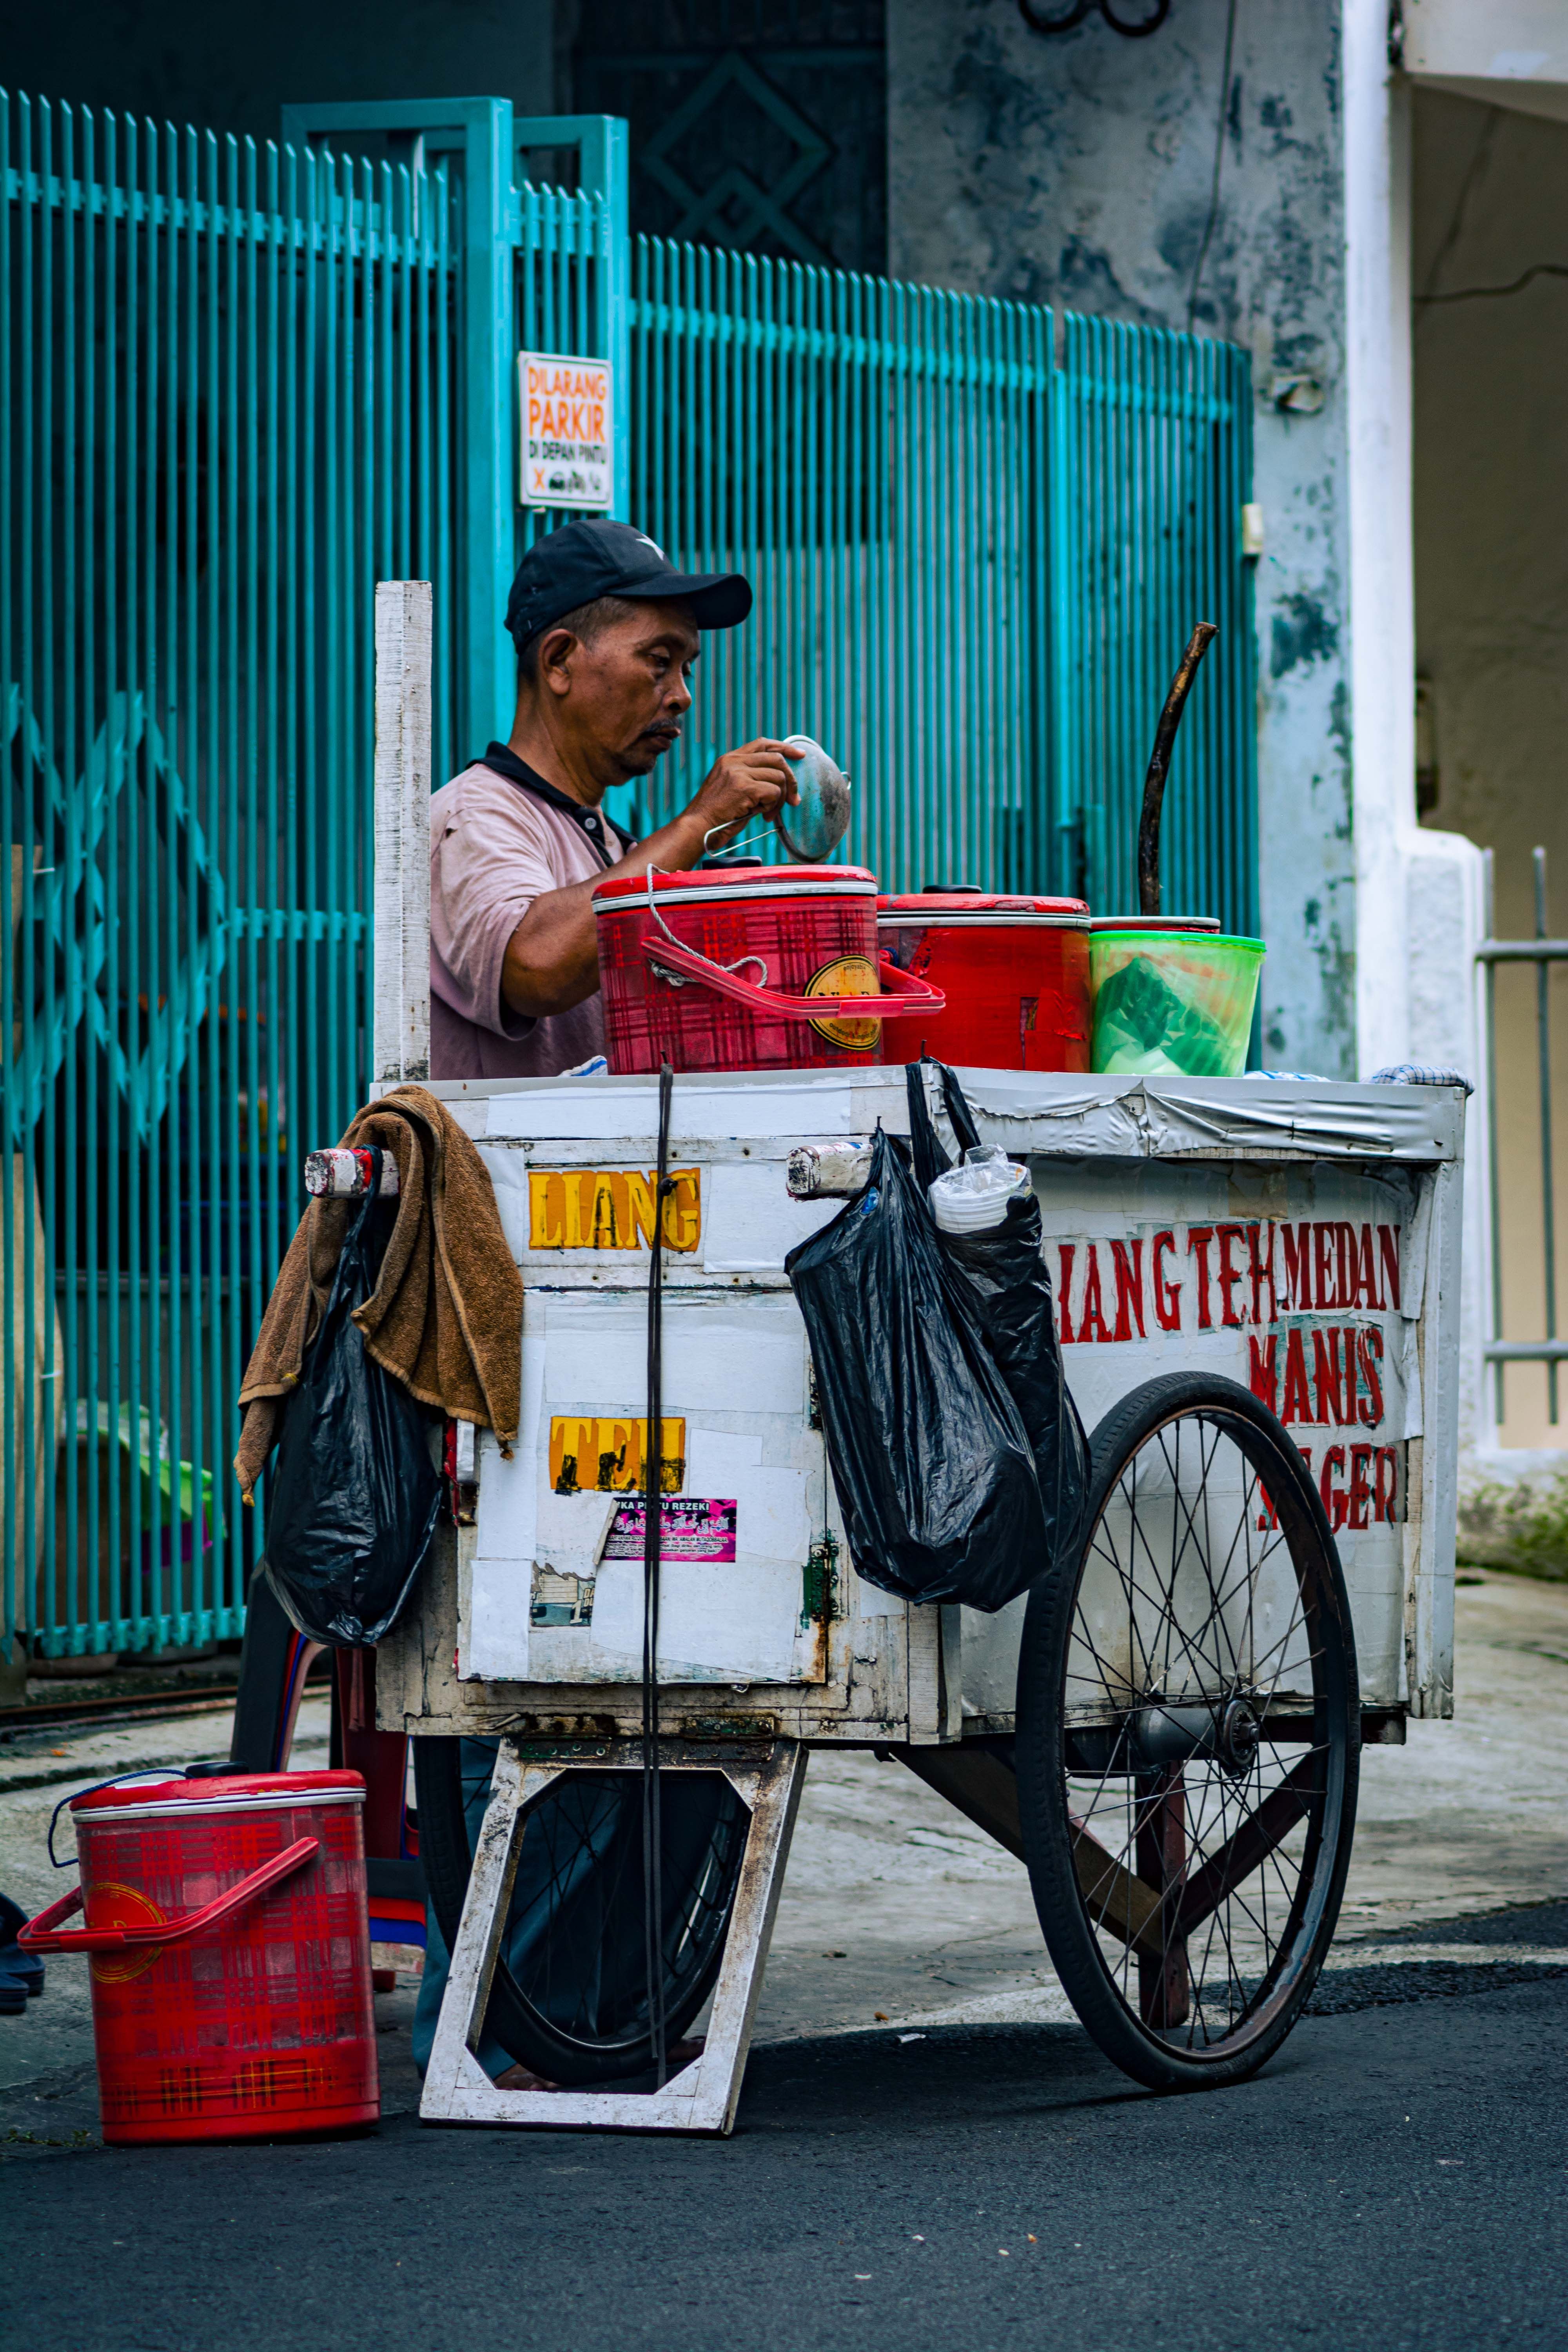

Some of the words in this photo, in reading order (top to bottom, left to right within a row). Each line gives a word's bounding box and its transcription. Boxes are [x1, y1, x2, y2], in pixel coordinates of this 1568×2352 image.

[528, 366, 606, 401] DILARANG
[528, 398, 606, 443] PARKIR
[529, 440, 539, 459] DI
[542, 441, 575, 461] DEPAN
[578, 444, 606, 465] PINTU
[529, 1172, 699, 1248] LIANG
[1054, 1230, 1181, 1344] IANG
[1186, 1222, 1278, 1329] TEH
[1280, 1221, 1401, 1312] MEDAN
[1248, 1326, 1384, 1428] MANIS
[551, 1417, 685, 1495] TEH
[1256, 1443, 1397, 1534] GER
